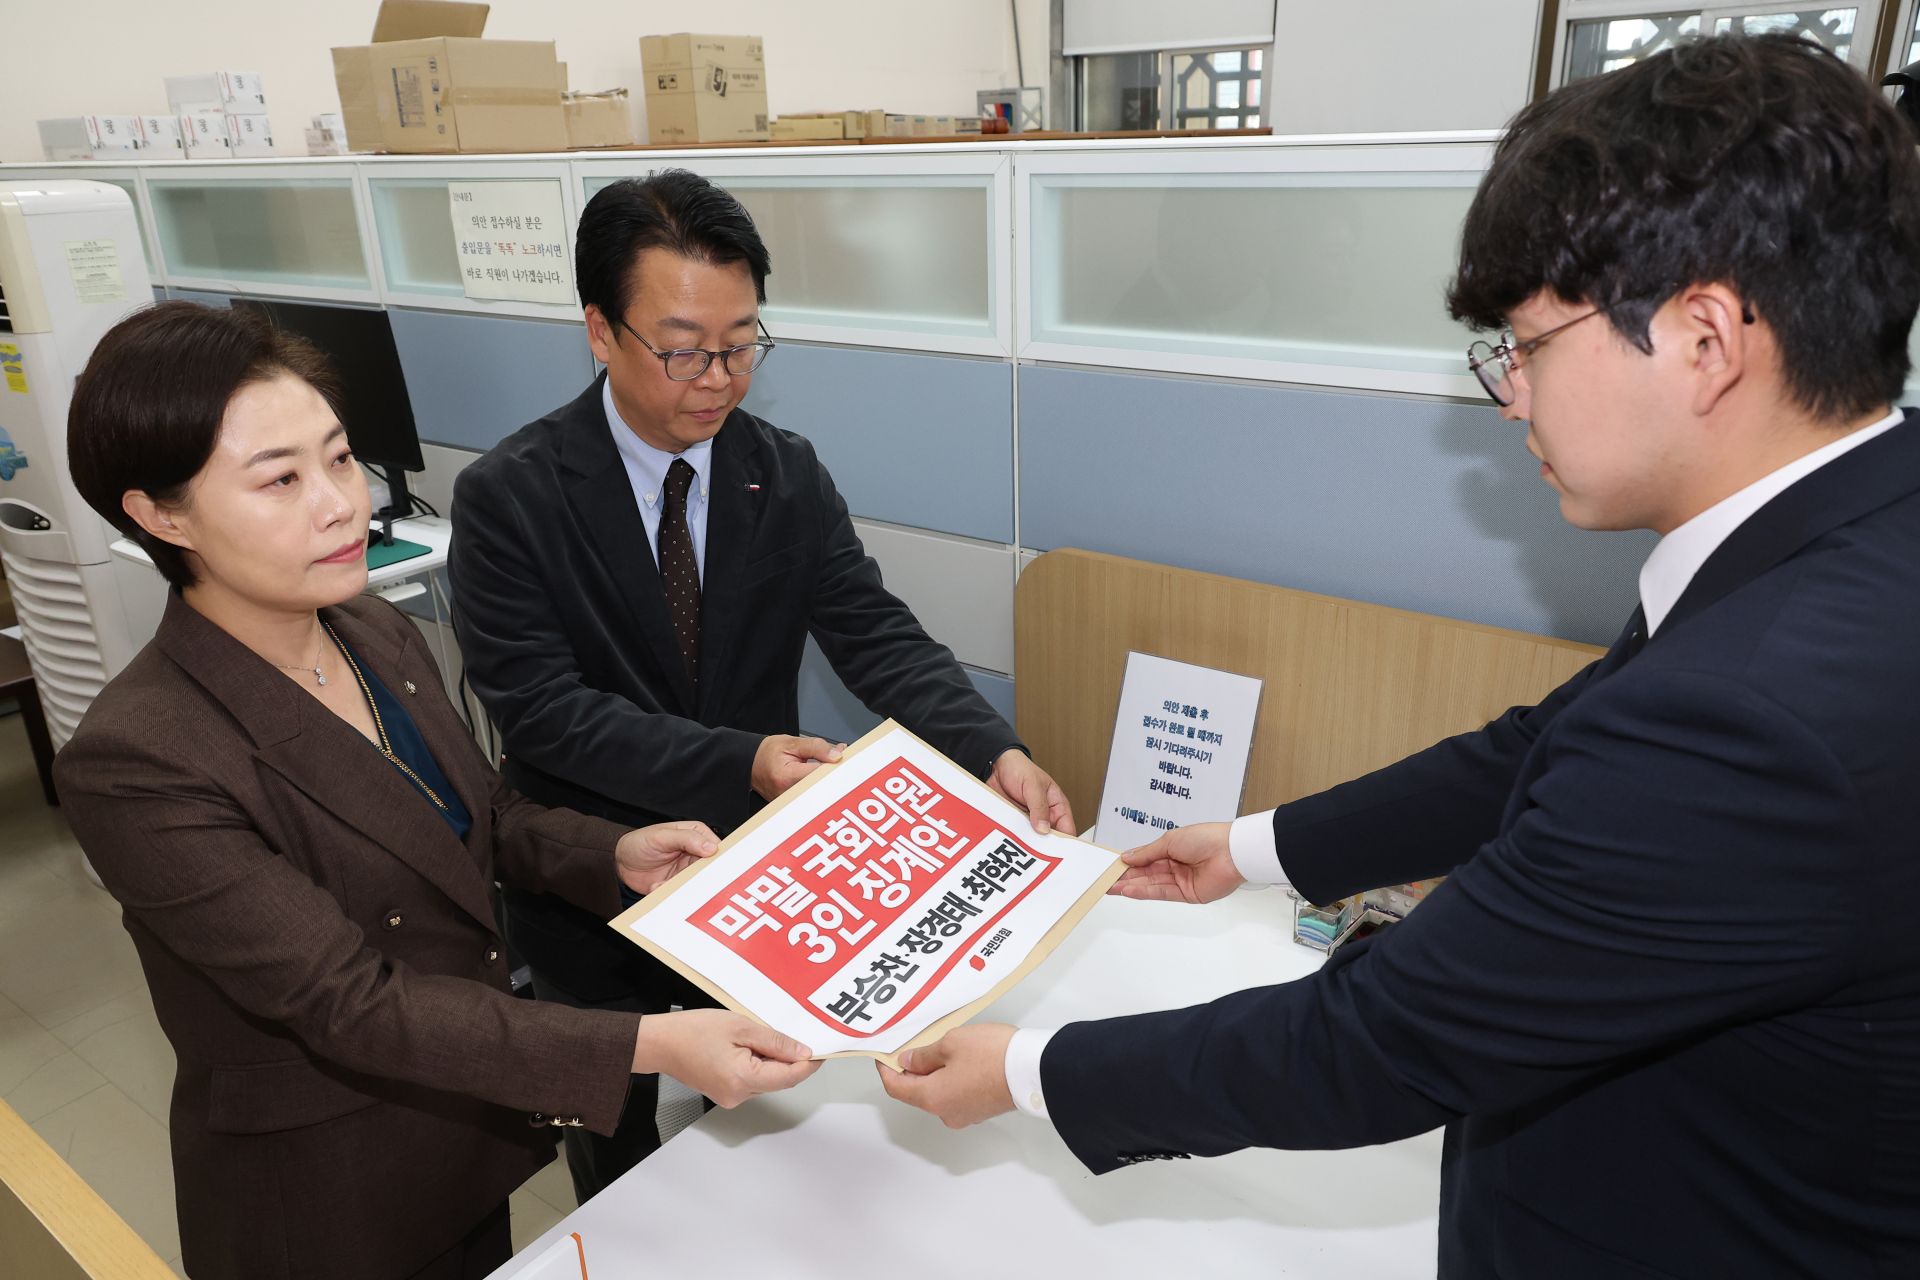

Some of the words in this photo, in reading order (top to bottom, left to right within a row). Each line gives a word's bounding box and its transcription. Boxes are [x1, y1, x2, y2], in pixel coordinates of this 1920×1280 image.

[472, 216, 487, 228] 의안
[490, 216, 521, 229] 접수하실
[525, 216, 542, 230] 분은
[522, 243, 562, 258] 노크하시면
[466, 267, 482, 279] 바로
[486, 268, 509, 281] 직원이
[512, 269, 564, 284] 나가겠습니다.
[1162, 700, 1180, 714] 의안
[1181, 704, 1198, 718] 제출
[1200, 709, 1209, 721] 후
[1143, 715, 1167, 731] 접수가
[1169, 721, 1185, 735] 완료
[1197, 729, 1223, 746] 때까지
[1146, 736, 1162, 750] 잠시
[1163, 741, 1213, 764] 기다려주시기
[1158, 760, 1193, 779] 바랍니다.
[1149, 778, 1192, 800] 감사합니다.
[1121, 806, 1149, 825] 이메일:
[1151, 815, 1180, 831] bill@
[707, 862, 814, 941] 막말
[790, 767, 945, 879] 국회의원
[786, 895, 880, 964] 3인
[847, 814, 971, 910] 징계안
[980, 927, 1013, 957] 국민의힘
